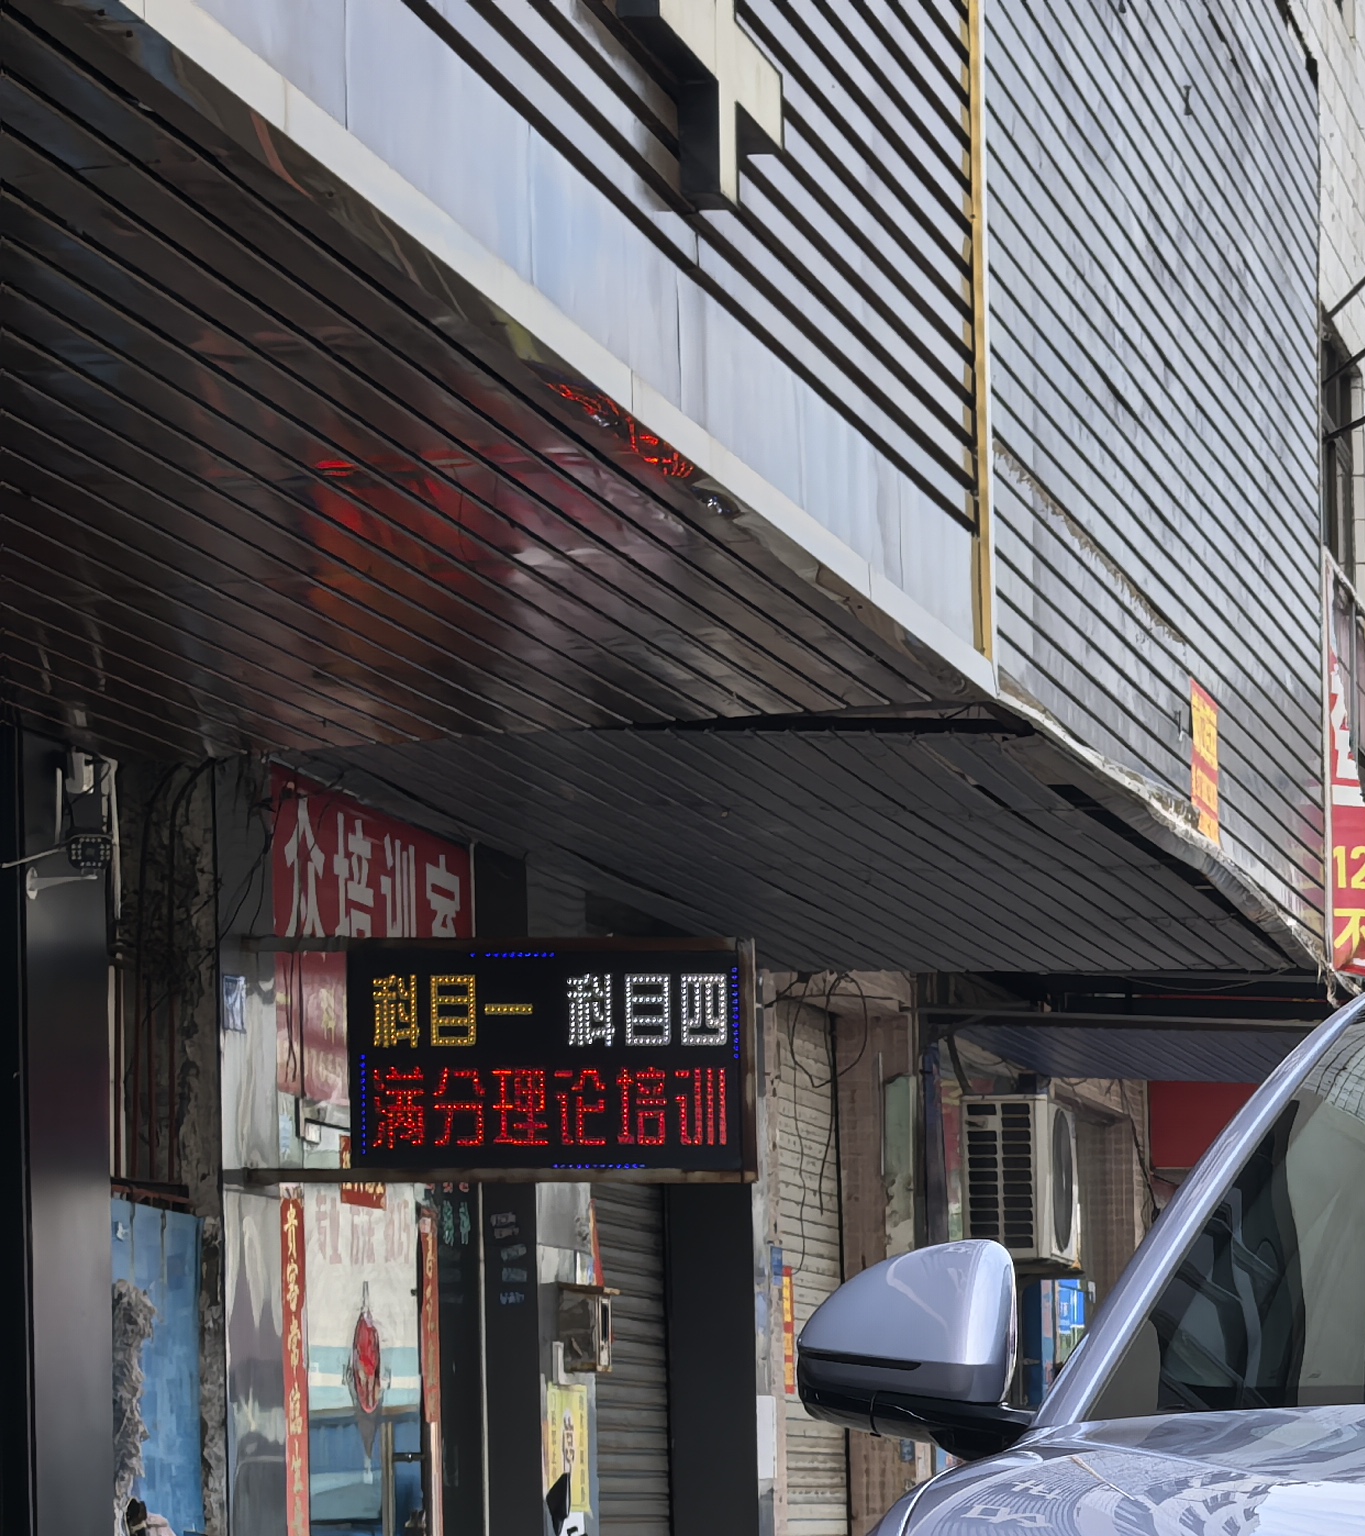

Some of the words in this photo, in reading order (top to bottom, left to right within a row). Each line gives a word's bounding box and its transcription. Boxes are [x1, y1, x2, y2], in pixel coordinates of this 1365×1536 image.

[372, 973, 534, 1048] 科目一
[566, 971, 728, 1048] 科目四
[372, 1066, 728, 1149] 满分理论培训
